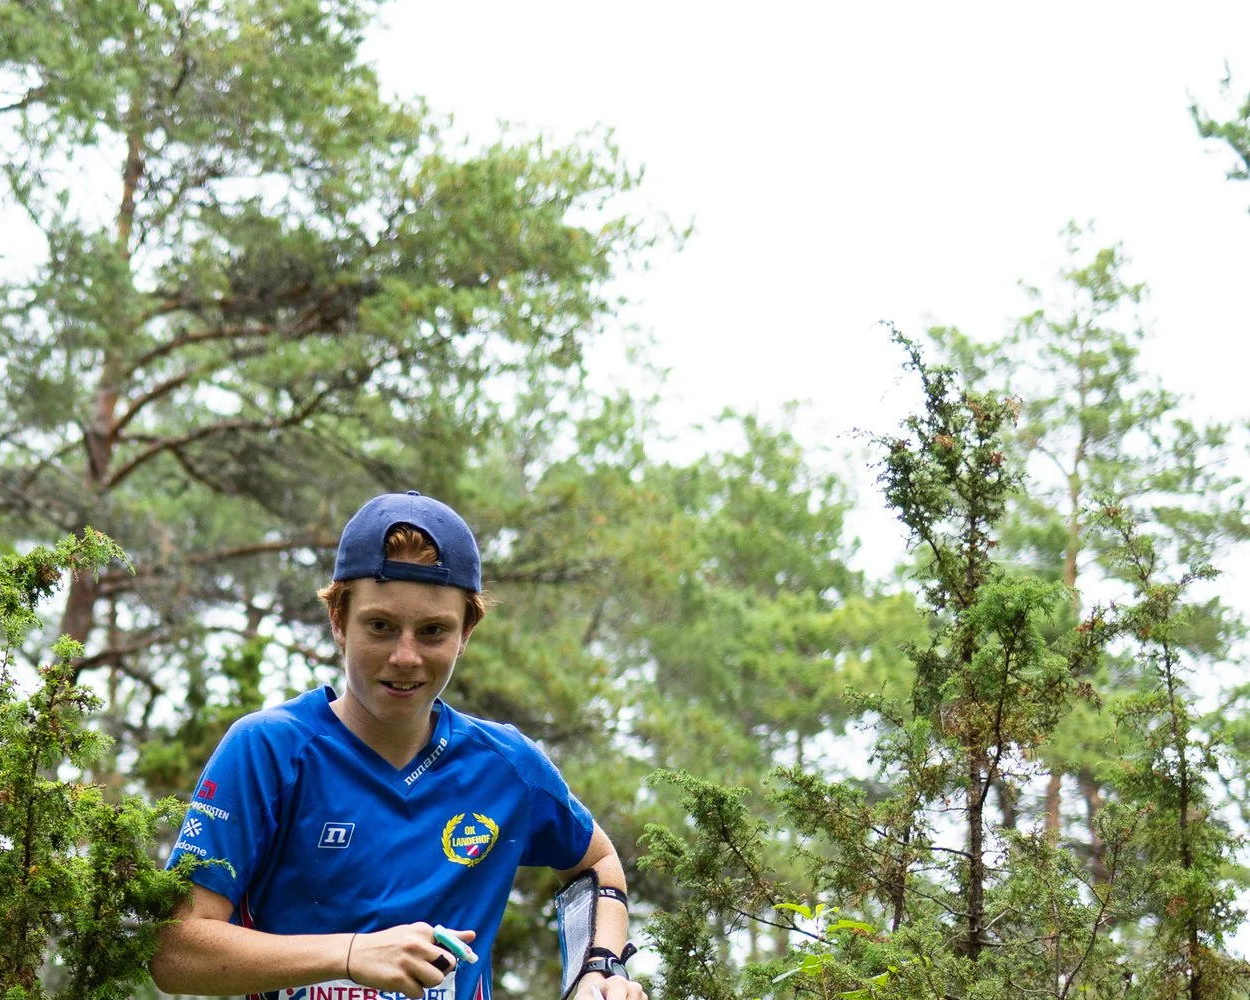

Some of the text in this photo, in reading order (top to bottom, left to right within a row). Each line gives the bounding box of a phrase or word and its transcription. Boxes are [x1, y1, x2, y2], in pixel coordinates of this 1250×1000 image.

[404, 737, 448, 785] noname
[464, 826, 476, 835] OK
[452, 834, 491, 847] LANDEHOF
